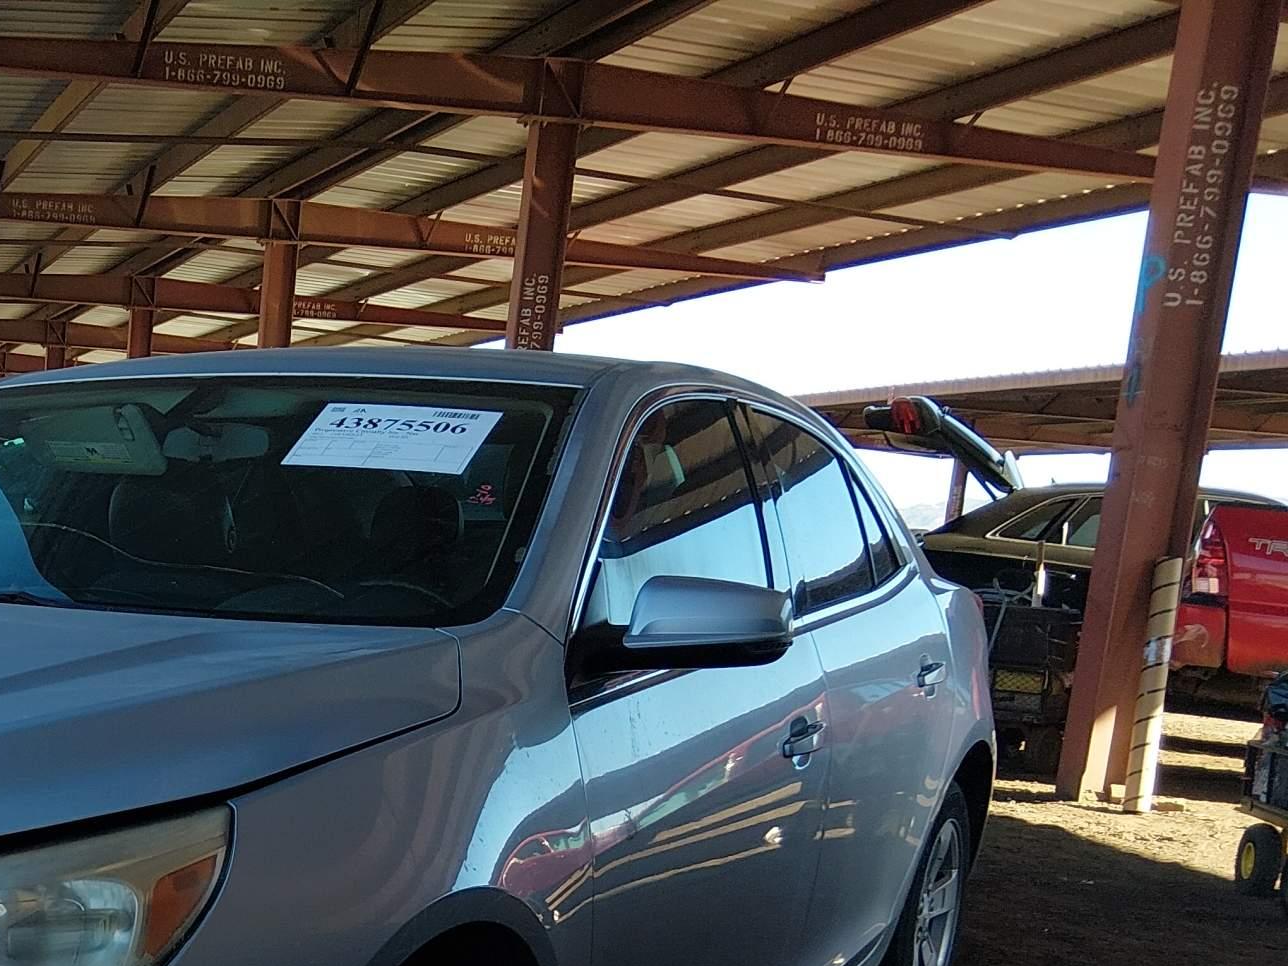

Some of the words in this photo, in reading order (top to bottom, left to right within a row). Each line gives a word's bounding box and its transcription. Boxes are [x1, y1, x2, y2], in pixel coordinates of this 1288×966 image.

[165, 50, 191, 65] U.S.
[199, 53, 253, 71] PREFAB
[260, 58, 287, 75] INC.
[165, 66, 285, 90] 1-866-799-0969
[1192, 81, 1220, 131] INC.
[816, 112, 840, 128] U.S.
[846, 116, 896, 134] PREFAB
[1173, 145, 1207, 245] PREFAB
[1185, 85, 1239, 306] 1-866-799-0969
[465, 233, 483, 244] U.S.
[522, 273, 537, 300] INC.
[1163, 259, 1189, 307] U.S.
[329, 416, 468, 436] 43875506
